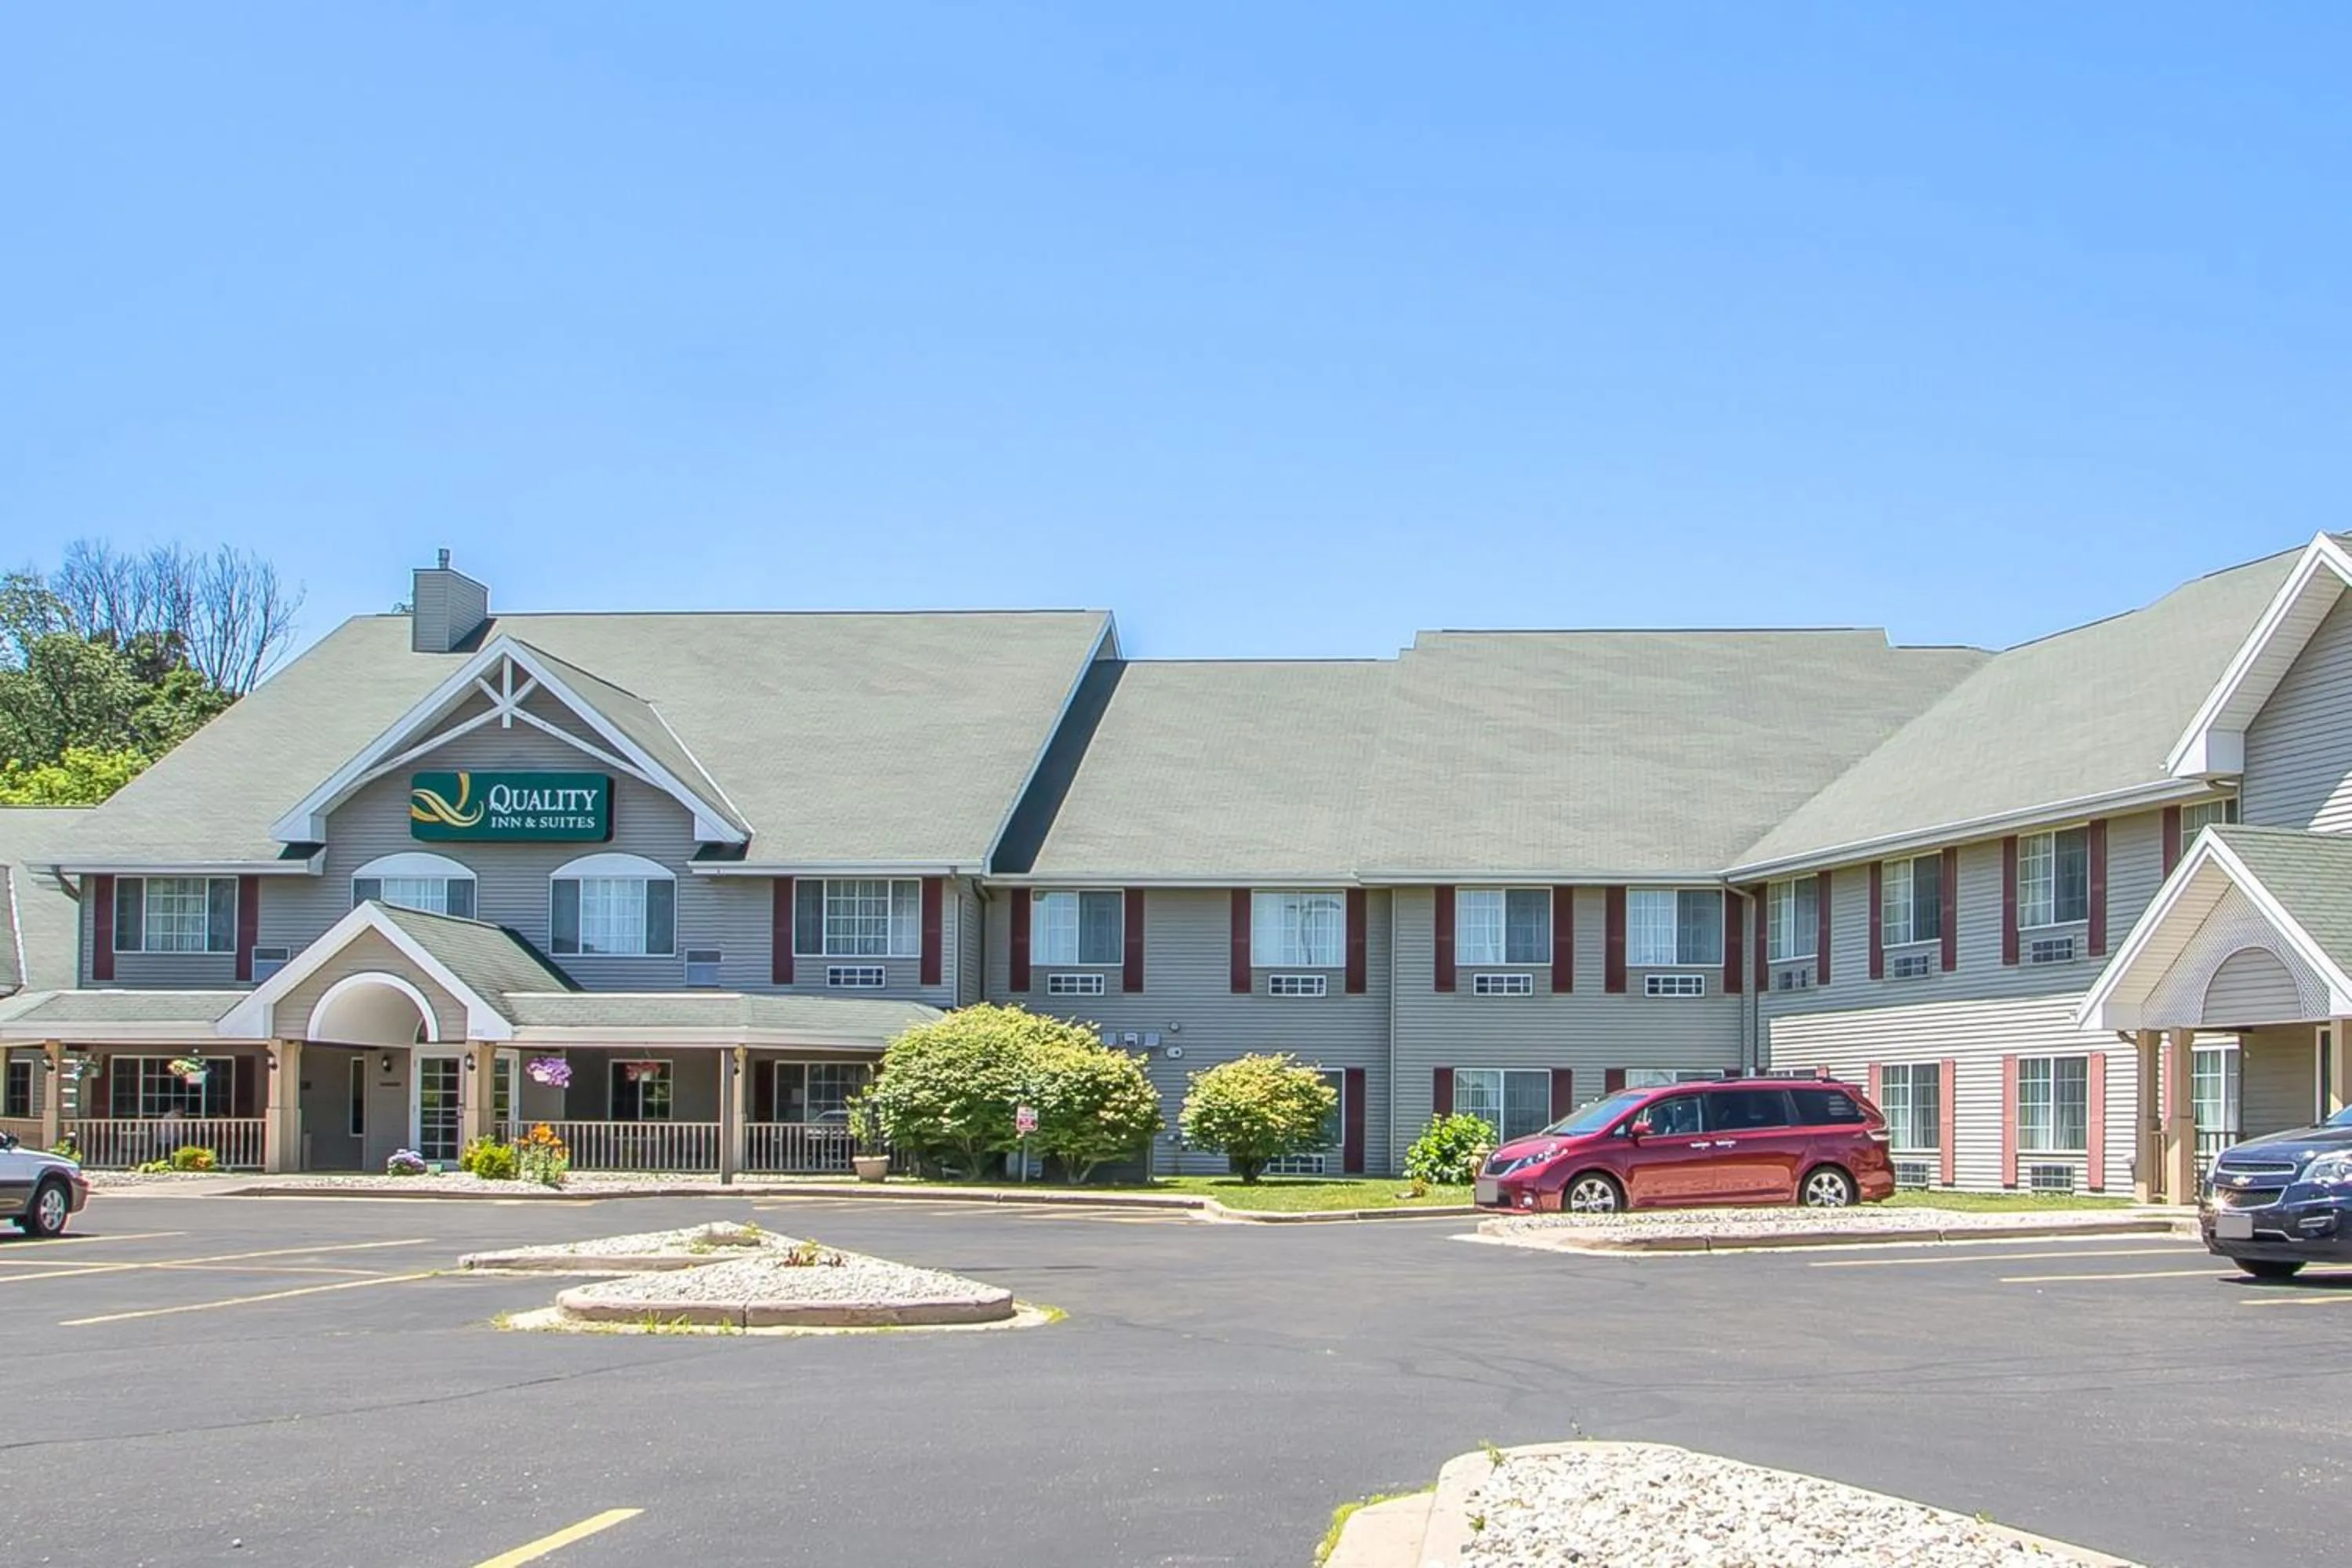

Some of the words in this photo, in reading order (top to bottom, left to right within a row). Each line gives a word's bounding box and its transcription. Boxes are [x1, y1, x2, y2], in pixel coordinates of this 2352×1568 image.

[488, 784, 598, 814] QUALITY
[491, 816, 521, 828] INN
[524, 816, 536, 828] &
[539, 816, 596, 828] SUITES
